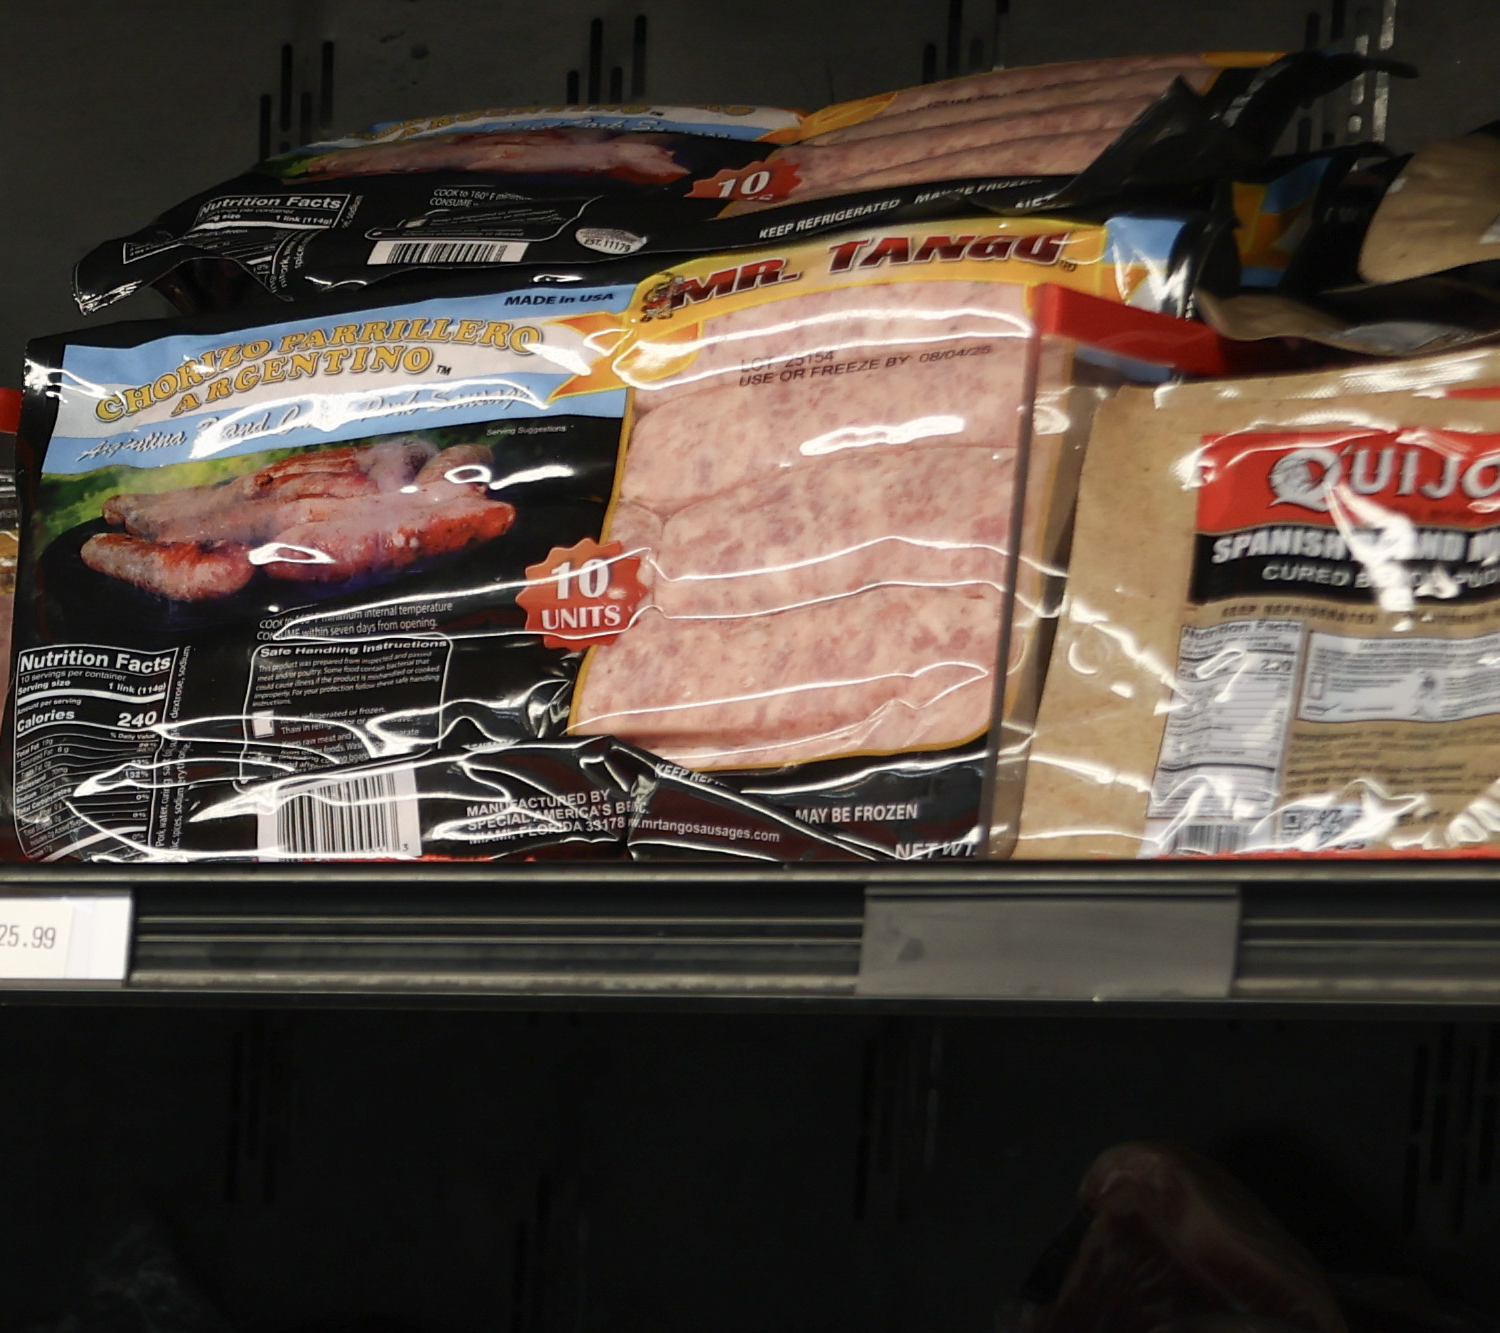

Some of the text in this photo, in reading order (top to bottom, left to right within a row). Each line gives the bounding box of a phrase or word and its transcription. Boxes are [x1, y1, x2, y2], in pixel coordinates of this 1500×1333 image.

[719, 171, 770, 197] 10
[203, 197, 341, 214] Nutrition Facts
[759, 198, 901, 240] KEEP REFRIGERATED
[668, 258, 803, 311] MR.
[504, 294, 555, 307] MADE
[578, 291, 616, 303] USA
[95, 317, 543, 424] CHORIZO PARRILLERO
[171, 344, 434, 416] ARGENTINO
[739, 371, 774, 387] USE
[779, 369, 806, 383] OR
[810, 358, 881, 381] FREEZE
[885, 354, 912, 371] BY
[1211, 528, 1348, 563] SPANISH
[550, 558, 610, 600] 10
[1261, 563, 1351, 588] CURED
[398, 602, 453, 616] temperature
[541, 605, 622, 631] UNITS
[377, 617, 439, 632] from opening.
[260, 640, 448, 658] Safe Handling Instructions
[20, 649, 172, 674] Nutrition Facts
[17, 682, 49, 697] Serving
[17, 709, 158, 733] Calories 240
[591, 788, 611, 802] BY
[467, 811, 531, 832] SPECIAL
[795, 803, 918, 824] MAY BE FROZEN
[518, 820, 583, 839] FLORIDA
